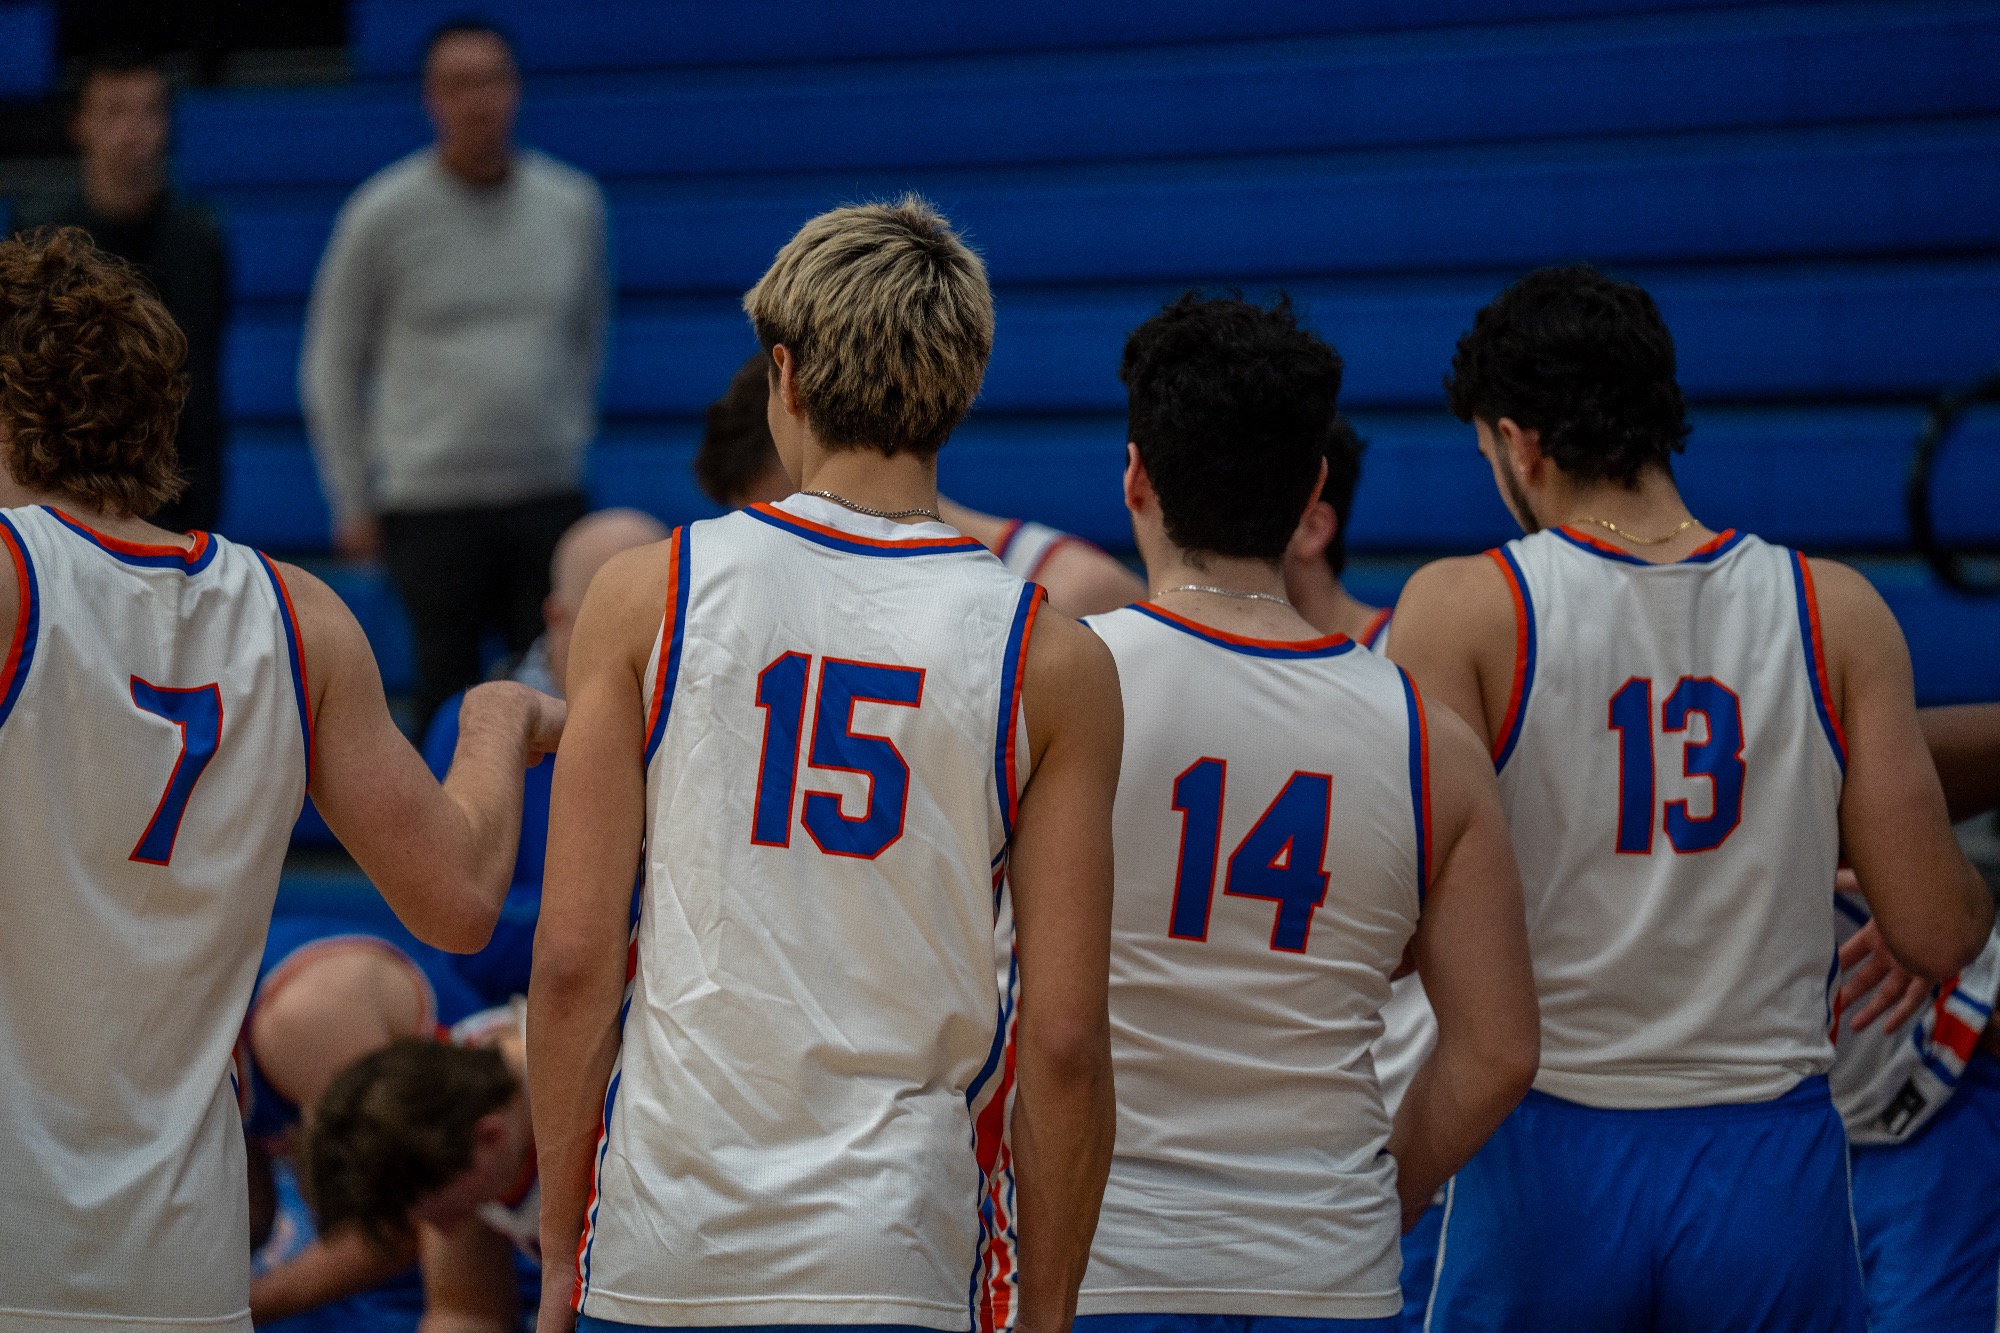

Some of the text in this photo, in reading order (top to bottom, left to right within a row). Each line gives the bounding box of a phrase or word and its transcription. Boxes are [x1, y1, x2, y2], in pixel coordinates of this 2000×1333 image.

[129, 675, 224, 866] 7
[750, 650, 926, 860] 15
[1608, 676, 1746, 855] 13
[1168, 756, 1332, 954] 14
